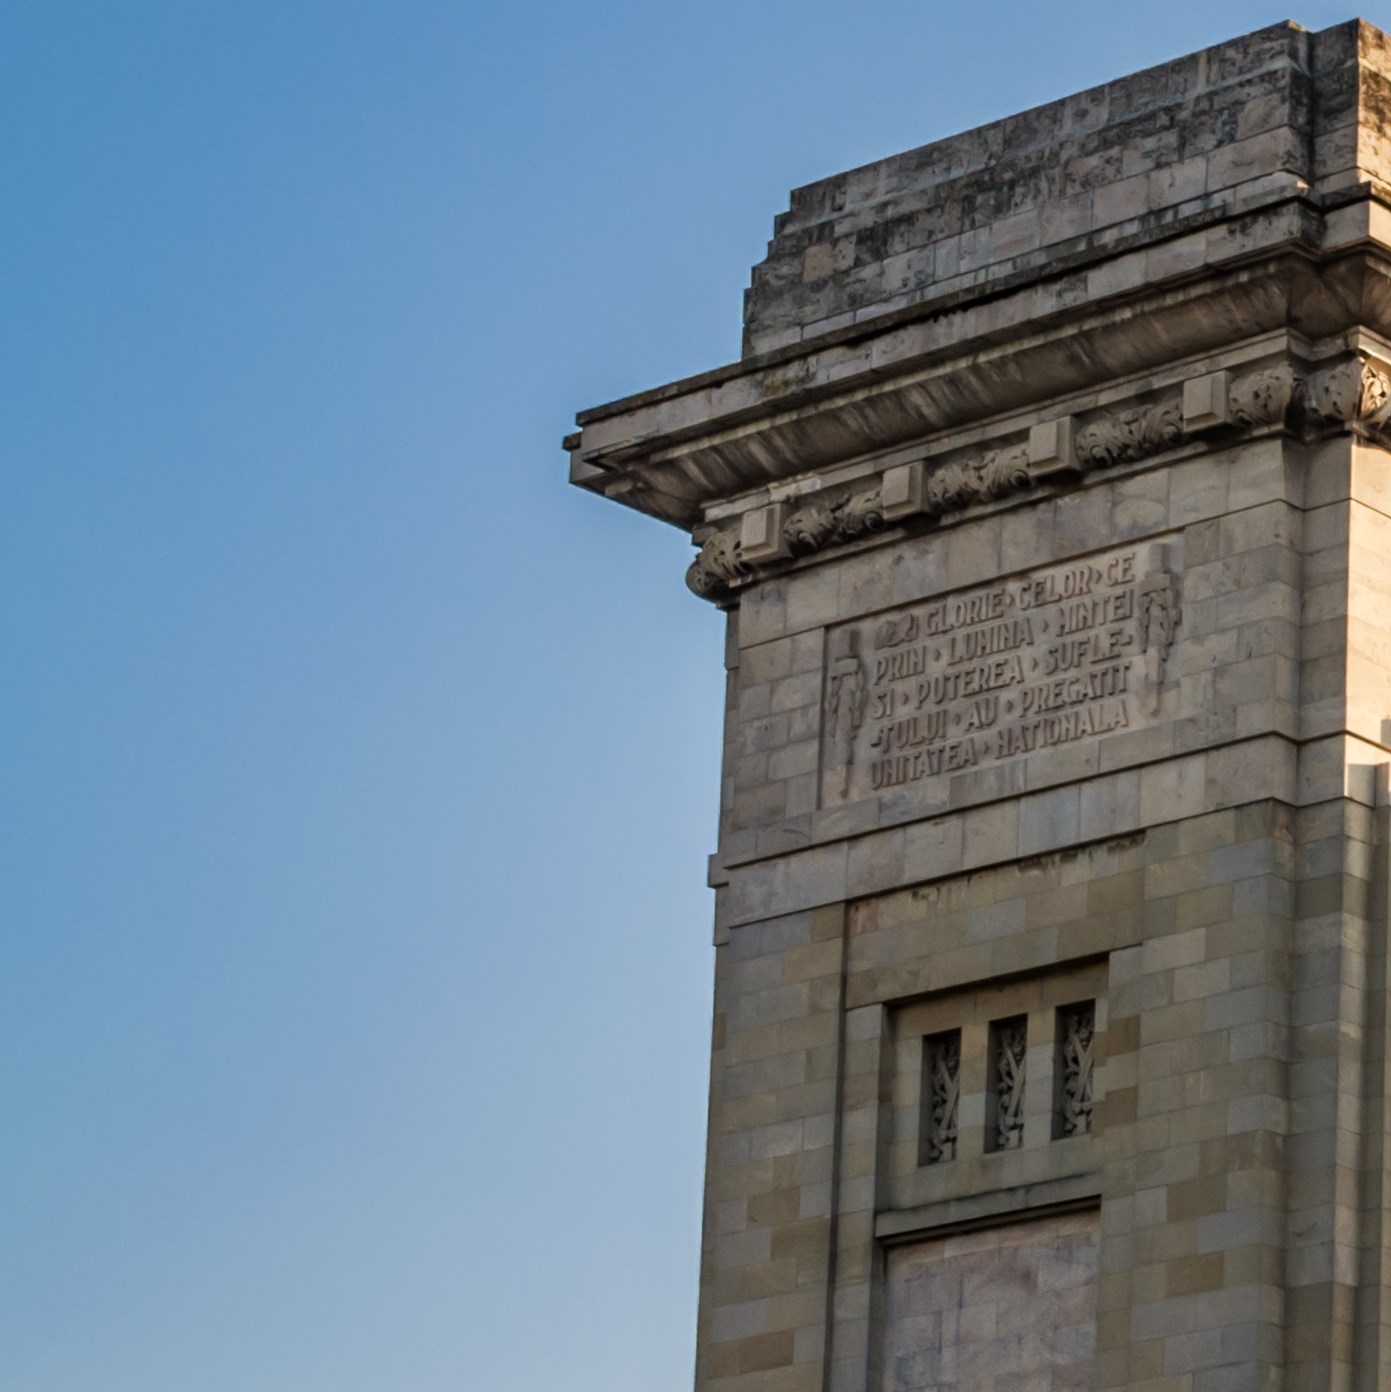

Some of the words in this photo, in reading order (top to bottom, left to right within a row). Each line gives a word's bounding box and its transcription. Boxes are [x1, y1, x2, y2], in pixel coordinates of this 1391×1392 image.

[926, 588, 1005, 637] GLORIE
[1017, 565, 1093, 611] CELOR
[1106, 553, 1136, 587] CE
[874, 645, 926, 686] PRIN
[947, 617, 1034, 667] LUMINA
[915, 654, 1025, 710] PUTEREA
[965, 696, 998, 733] AU
[1019, 661, 1131, 718] PREGATIT
[871, 737, 979, 791] UNITATEA
[995, 698, 1130, 760] NATIONALA
